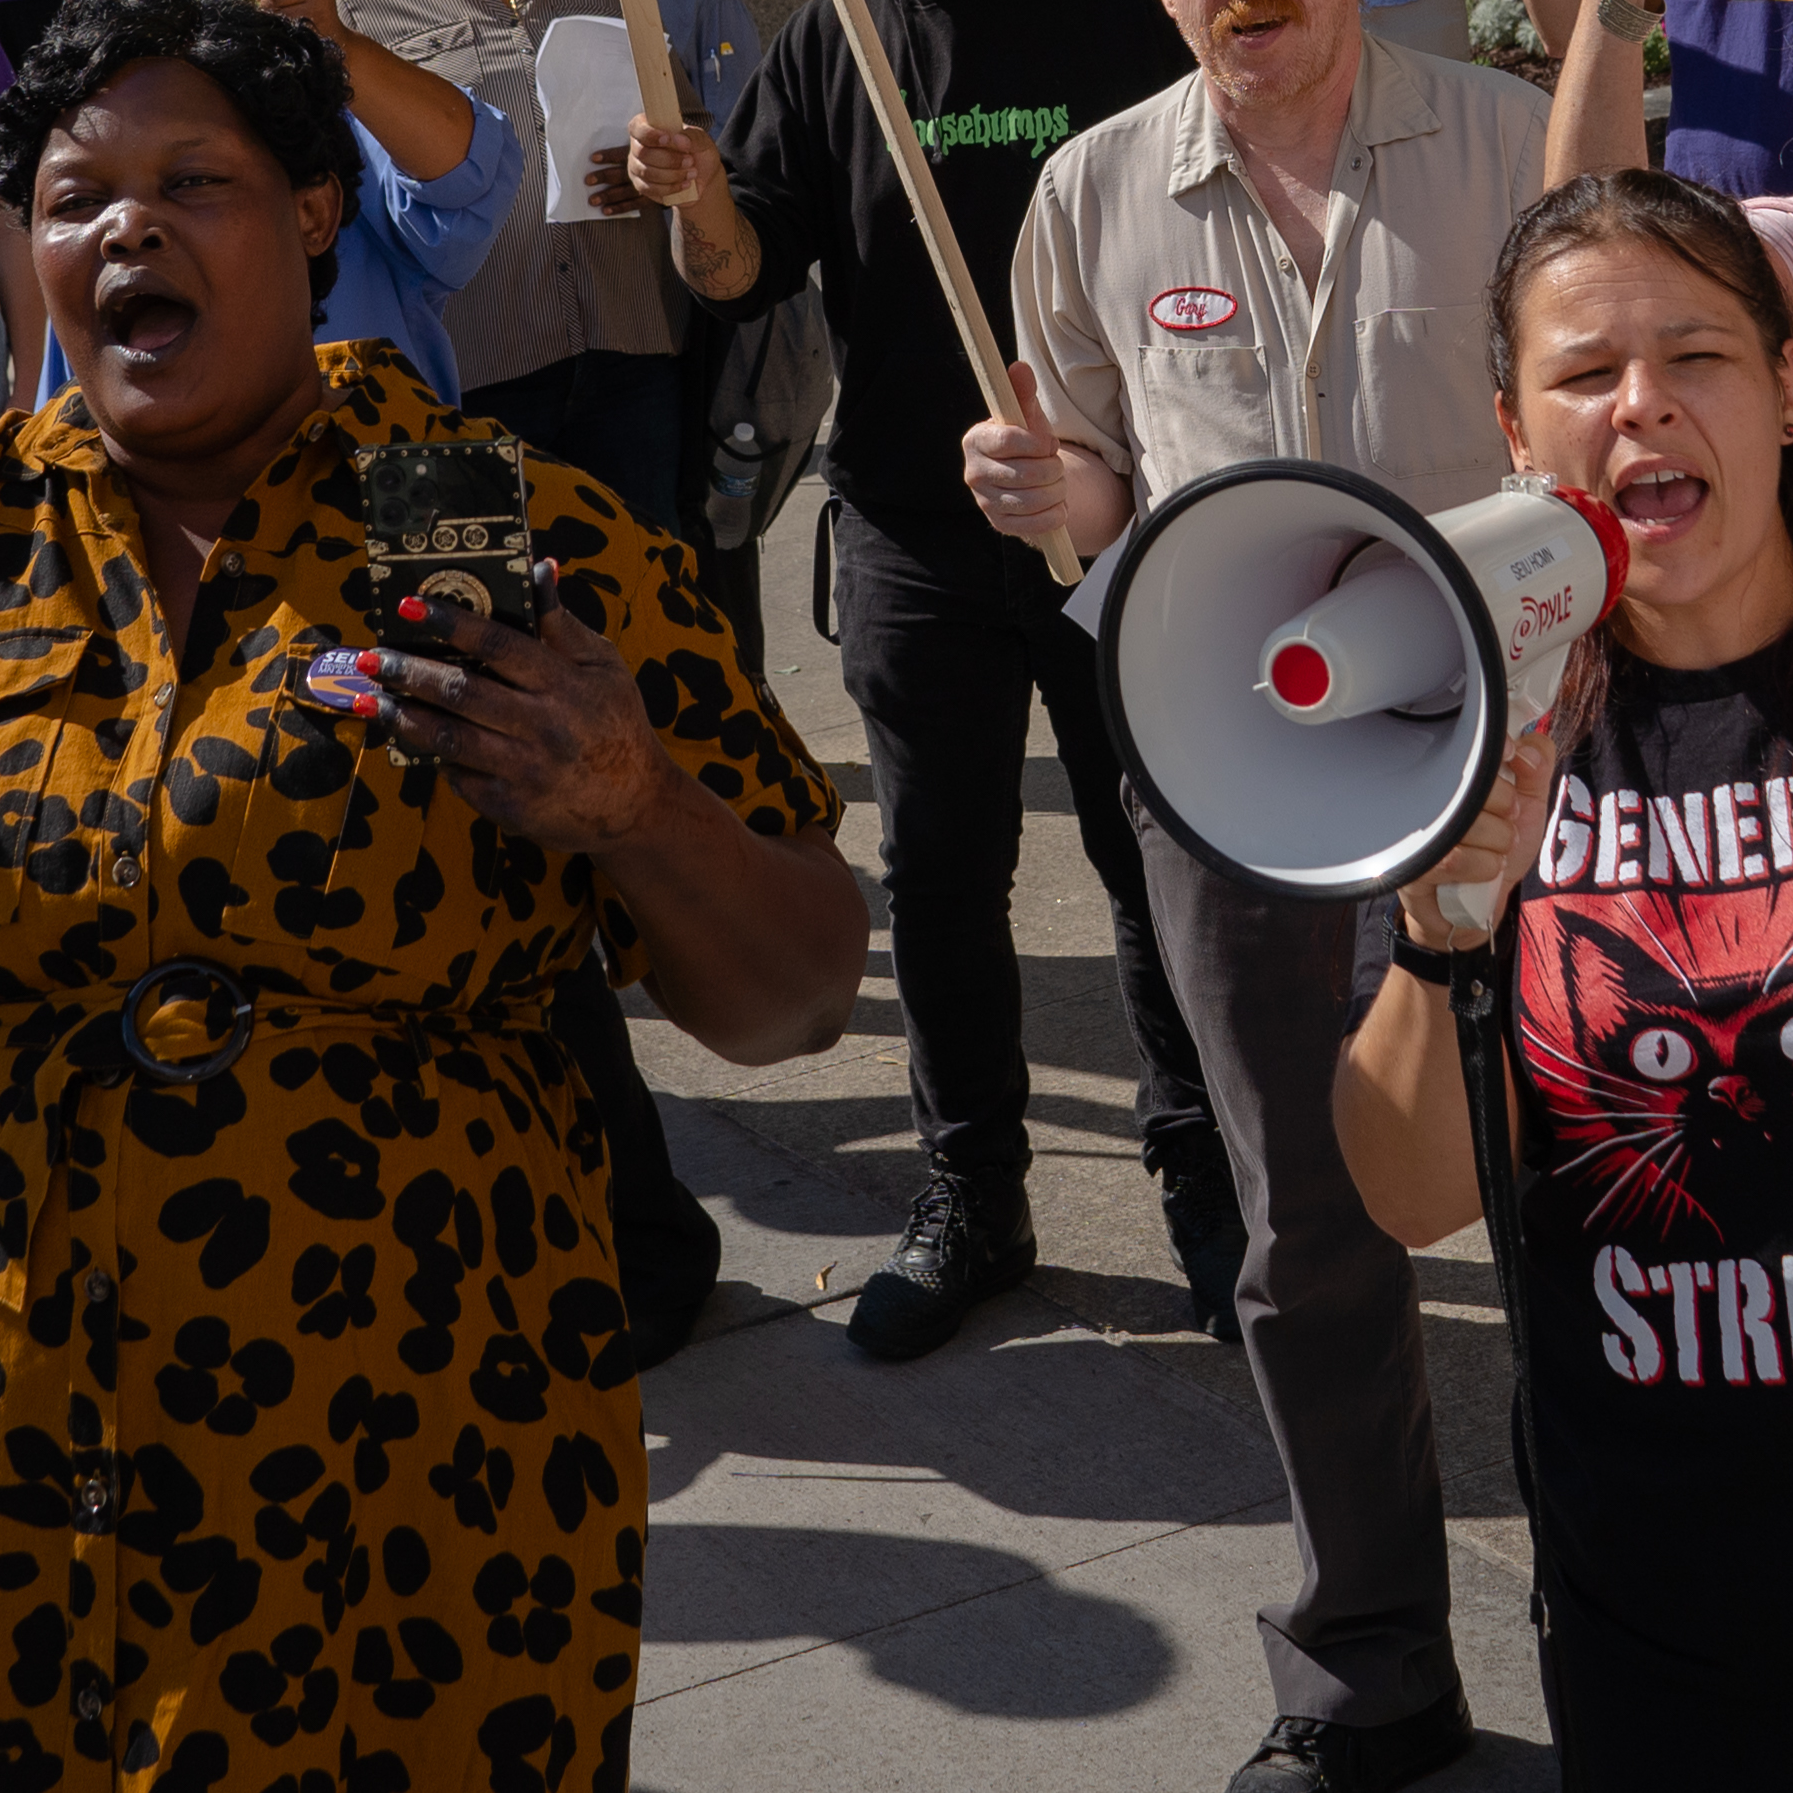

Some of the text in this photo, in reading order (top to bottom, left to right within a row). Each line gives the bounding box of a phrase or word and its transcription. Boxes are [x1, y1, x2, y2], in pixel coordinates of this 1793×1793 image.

[888, 90, 1070, 159] oosebumps
[1176, 297, 1207, 321] Gary
[1510, 557, 1533, 581] SEIU
[1537, 584, 1573, 636] PYLE
[323, 651, 358, 664] SEI
